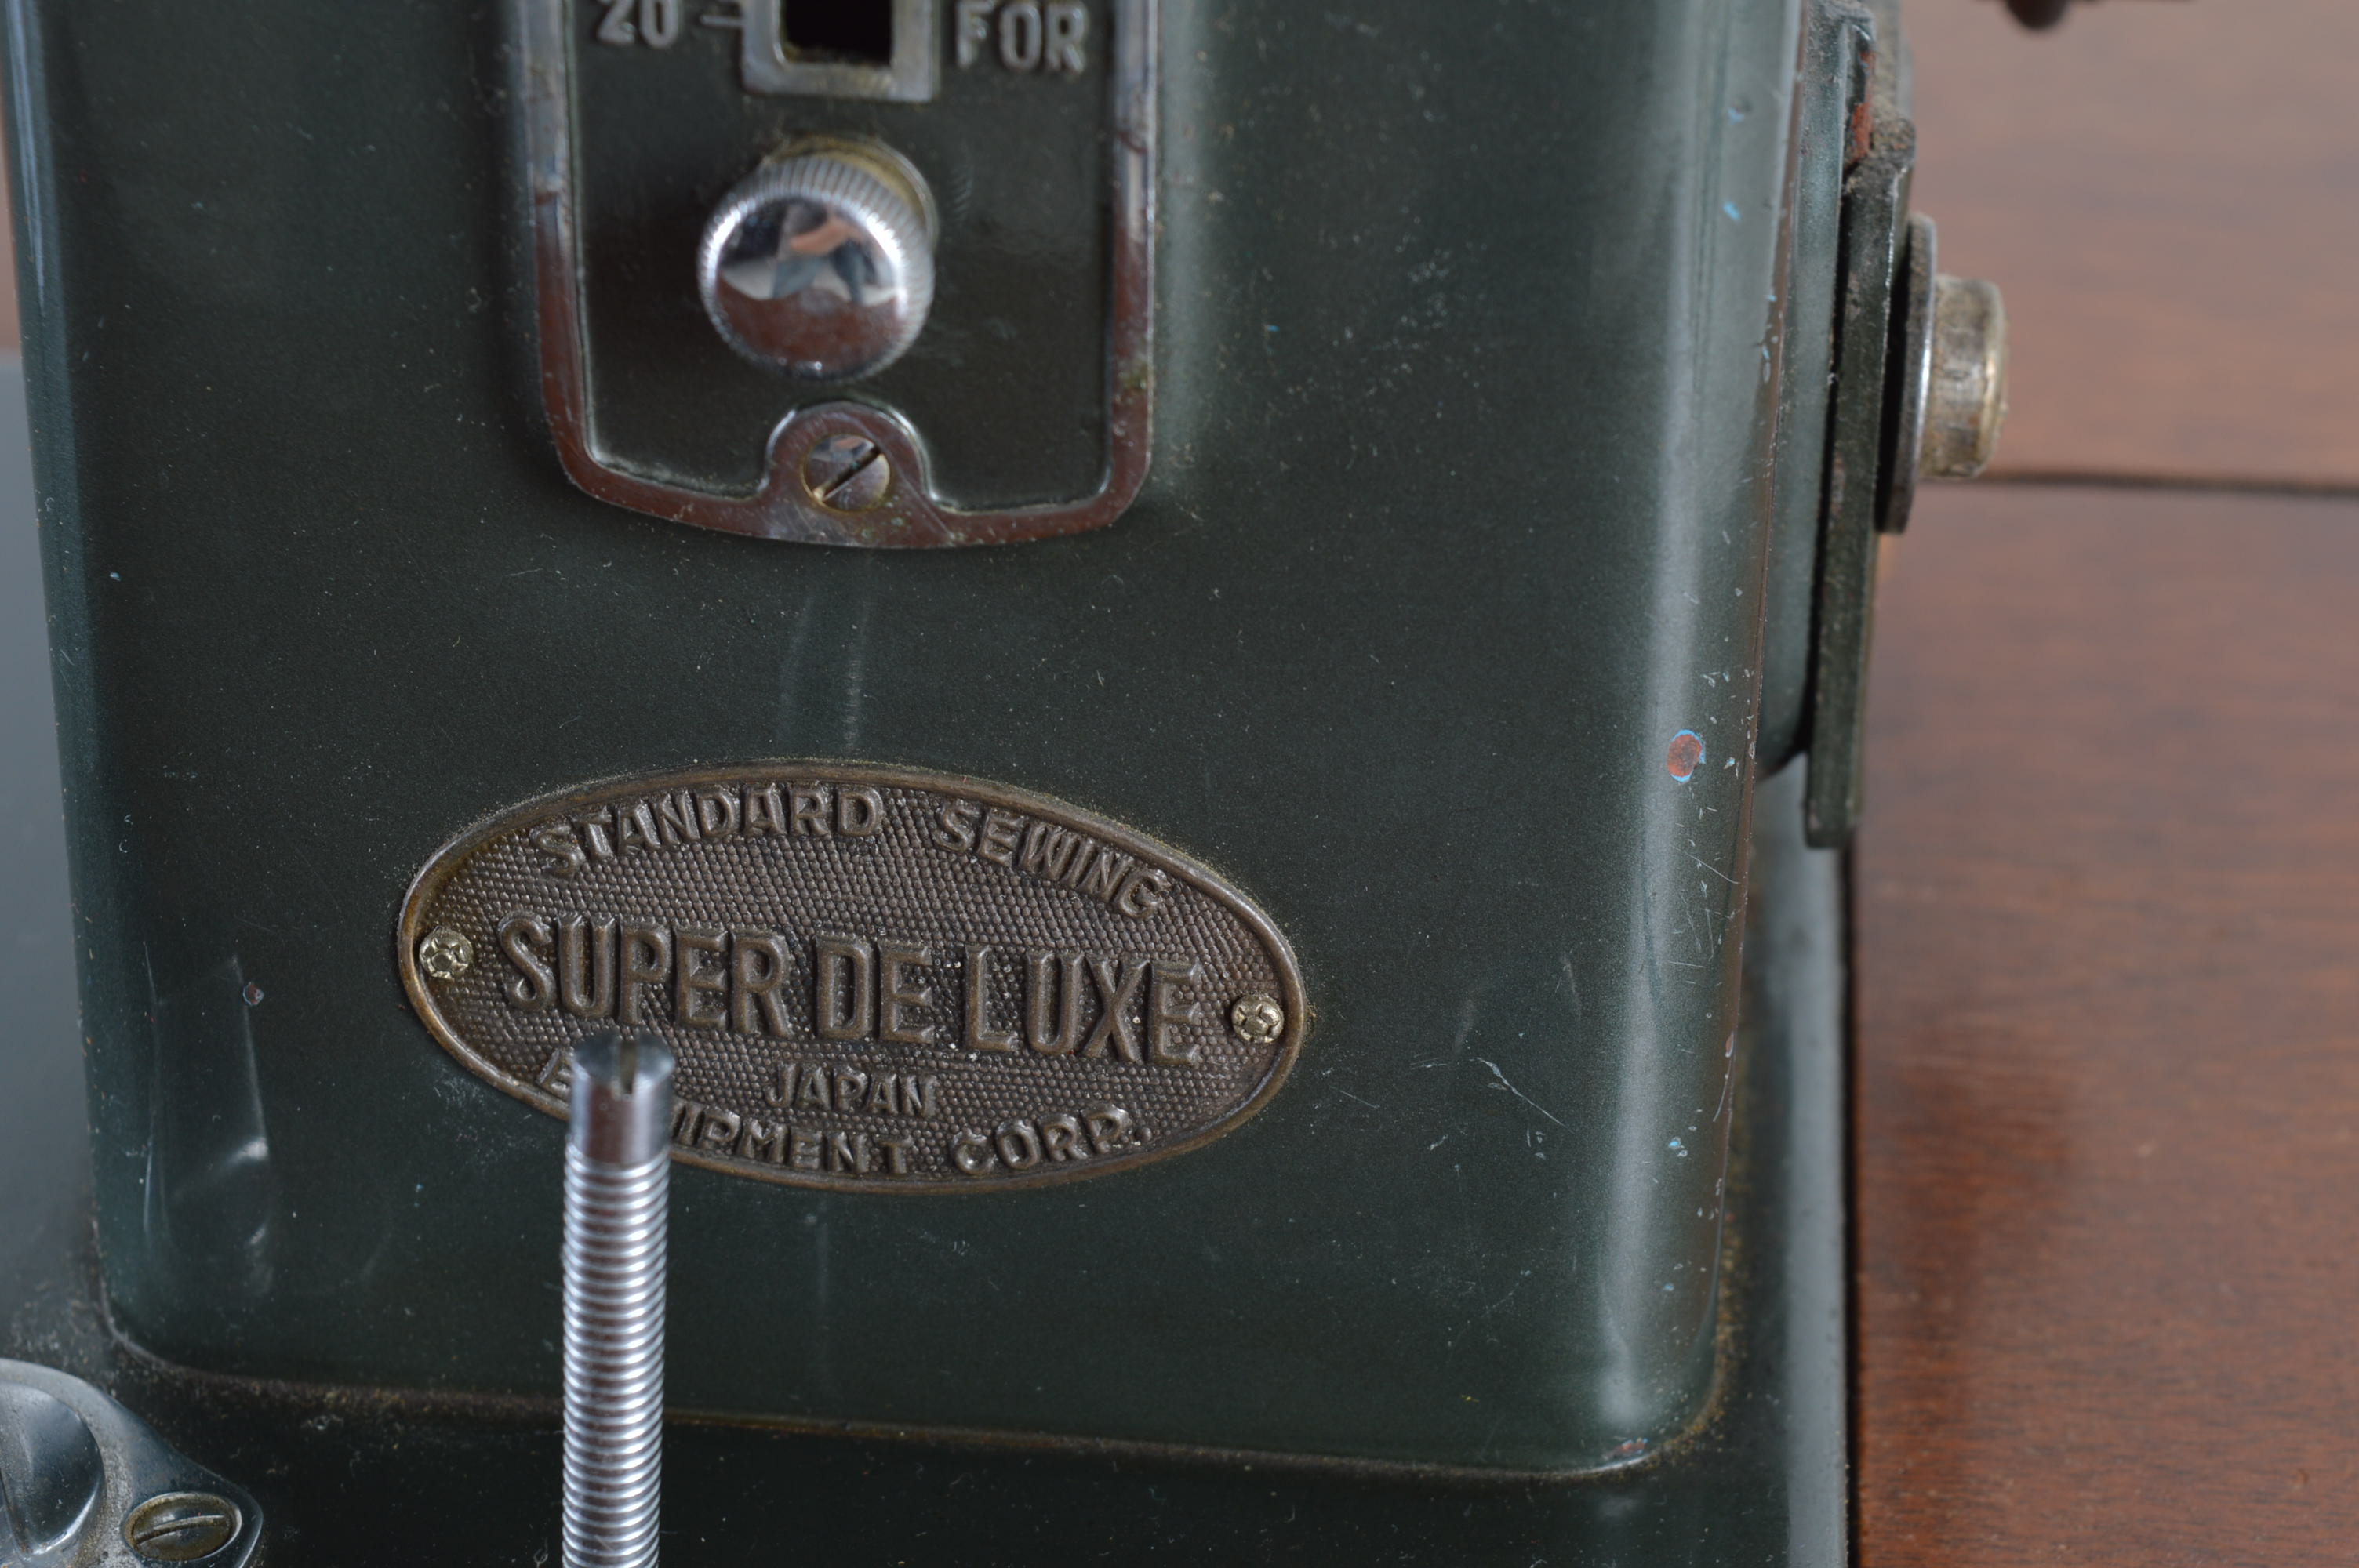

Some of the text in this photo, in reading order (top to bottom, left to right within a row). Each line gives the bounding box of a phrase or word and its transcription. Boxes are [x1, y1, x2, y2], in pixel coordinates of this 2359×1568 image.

[598, 0, 679, 49] 20
[956, 0, 1088, 74] FOR
[530, 783, 1169, 920] STANDARD SEWING
[497, 911, 1203, 1067] SUPER DE LUXE
[538, 1048, 1153, 1175] EIPMENT CORP.
[766, 1061, 938, 1118] JAPAN
